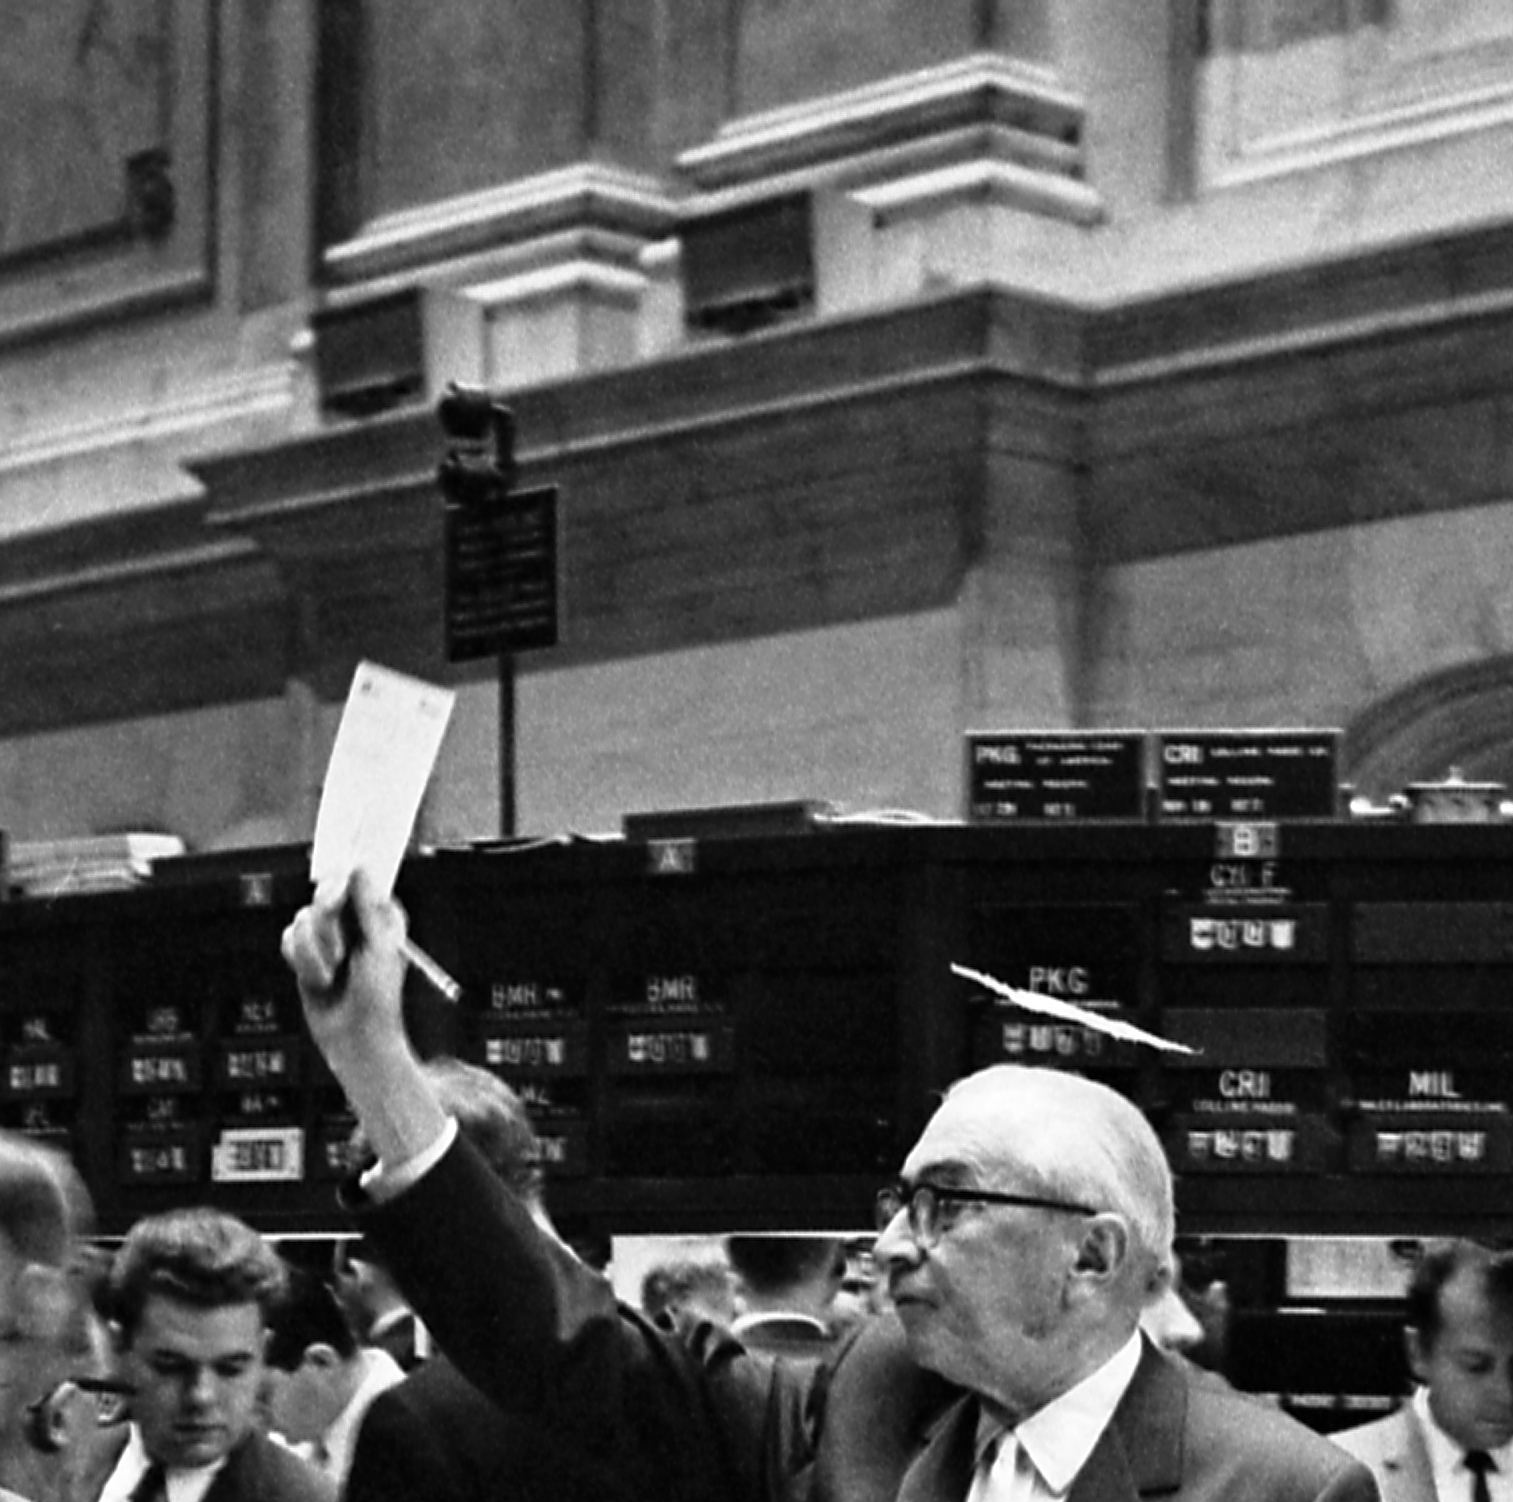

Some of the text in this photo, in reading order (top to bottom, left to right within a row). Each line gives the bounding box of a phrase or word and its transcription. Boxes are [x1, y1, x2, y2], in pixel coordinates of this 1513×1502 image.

[1029, 966, 1088, 994] PKG
[1219, 1069, 1270, 1098] CRI
[1409, 1070, 1463, 1098] MIL
